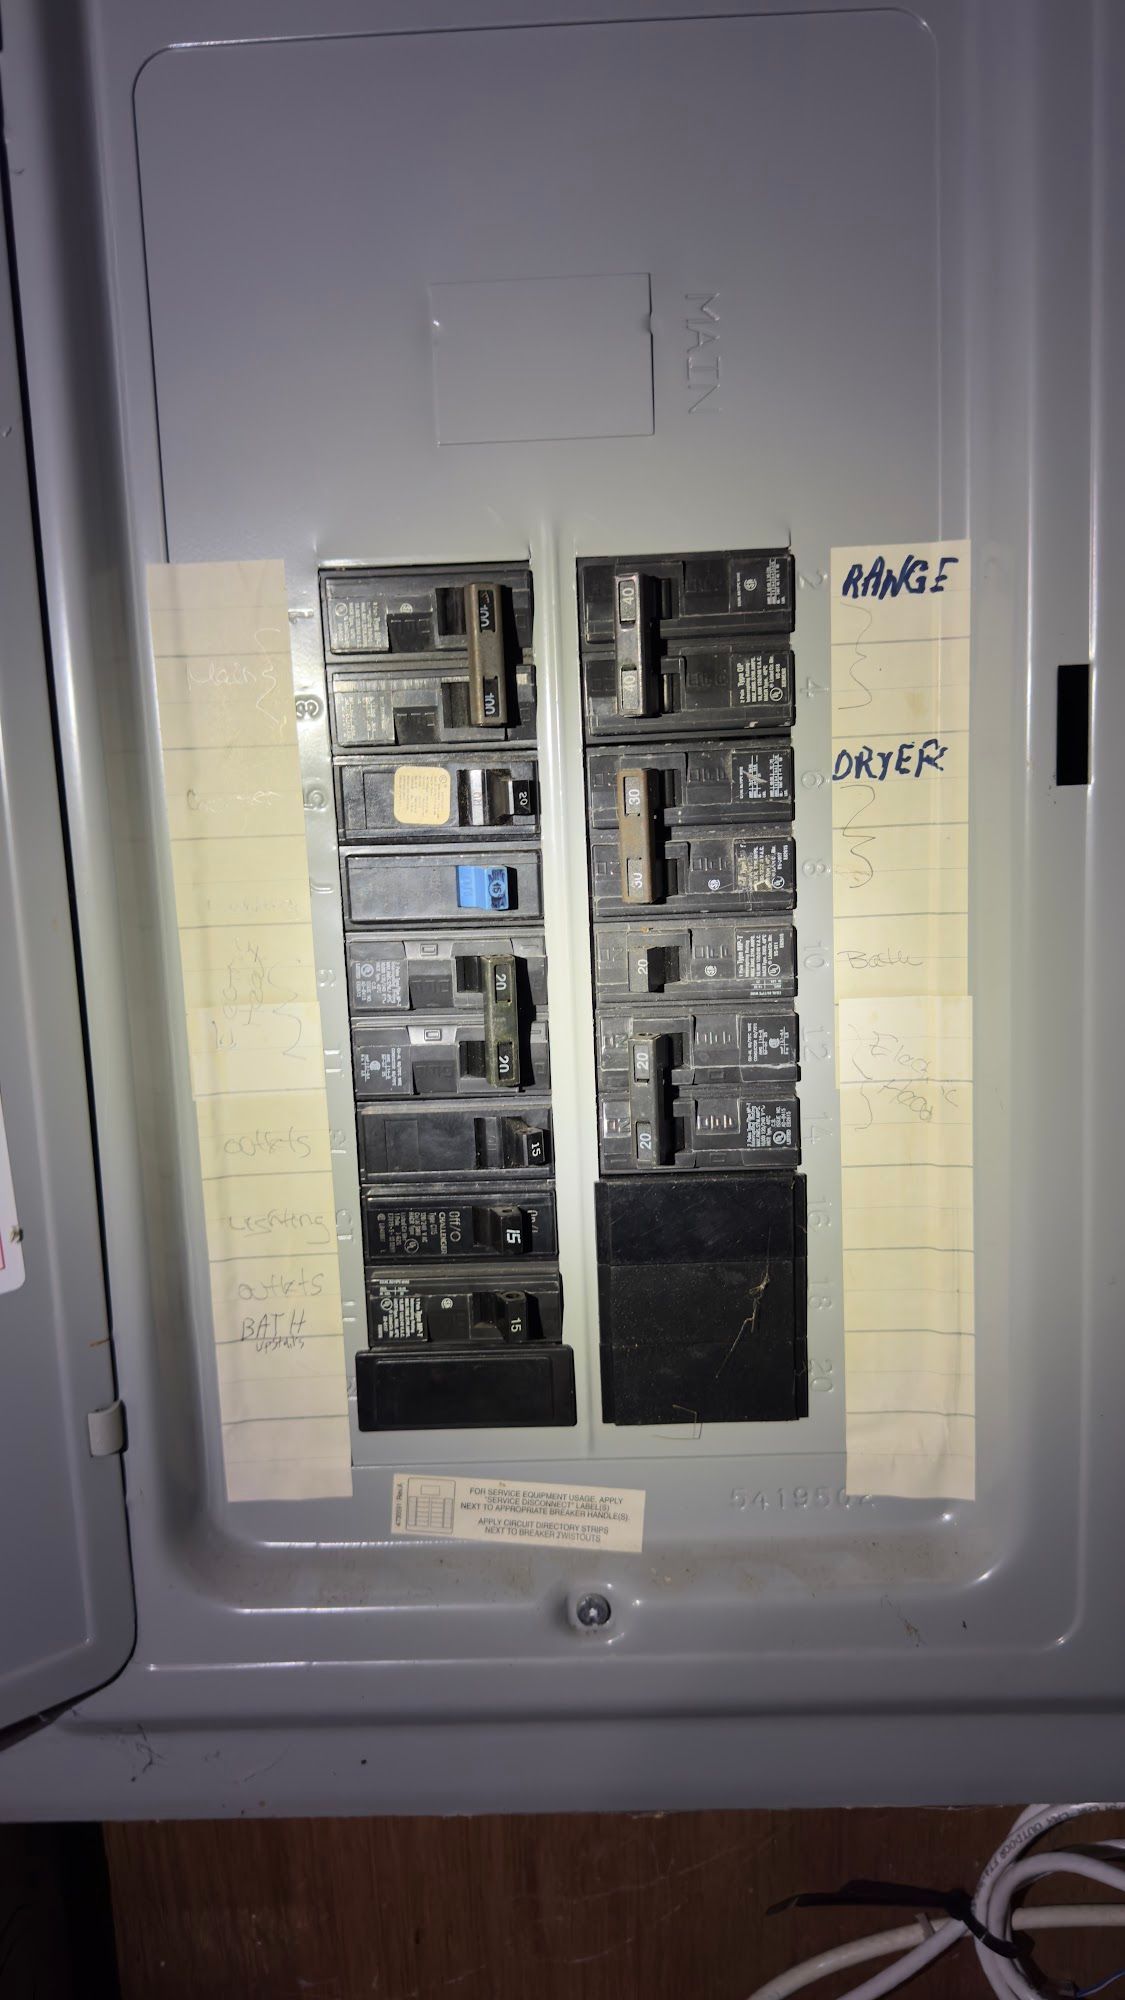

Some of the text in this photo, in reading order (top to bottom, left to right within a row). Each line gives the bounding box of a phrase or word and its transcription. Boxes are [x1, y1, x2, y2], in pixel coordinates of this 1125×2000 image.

[684, 291, 721, 415] MAIN
[841, 554, 960, 601] RANGE
[624, 587, 636, 606] 40
[623, 675, 636, 693] 40
[737, 673, 745, 687] Type
[831, 738, 949, 781] DRYER
[518, 791, 528, 806] 20
[628, 788, 641, 806] 30
[631, 872, 643, 889] 30
[637, 959, 649, 975] 20
[496, 973, 507, 991] 20
[499, 1055, 510, 1073] 20
[637, 1052, 649, 1070] 20
[531, 1141, 541, 1157] 15
[639, 1132, 652, 1149] 20
[438, 1211, 448, 1255] CHALLENGER
[506, 1228, 521, 1244] 15
[240, 1308, 307, 1342] BATH
[510, 1317, 522, 1332] 15
[469, 1487, 486, 1496] FOR
[487, 1488, 521, 1499] SERVICE
[522, 1490, 567, 1502] EQUIPMENT
[598, 1496, 624, 1505] APPLY
[460, 1502, 481, 1511] NEXT
[483, 1503, 494, 1512] TO
[495, 1504, 548, 1516] APPROPRIATE
[549, 1508, 586, 1518] BREAKER
[477, 1517, 609, 1535] APPLY CIRCUIT DIRECTORY STRIPS
[484, 1526, 505, 1535] NEXT
[507, 1527, 518, 1536] TO
[519, 1528, 556, 1539] BREAKER
[999, 1822, 1043, 1859] OUTDOOR
